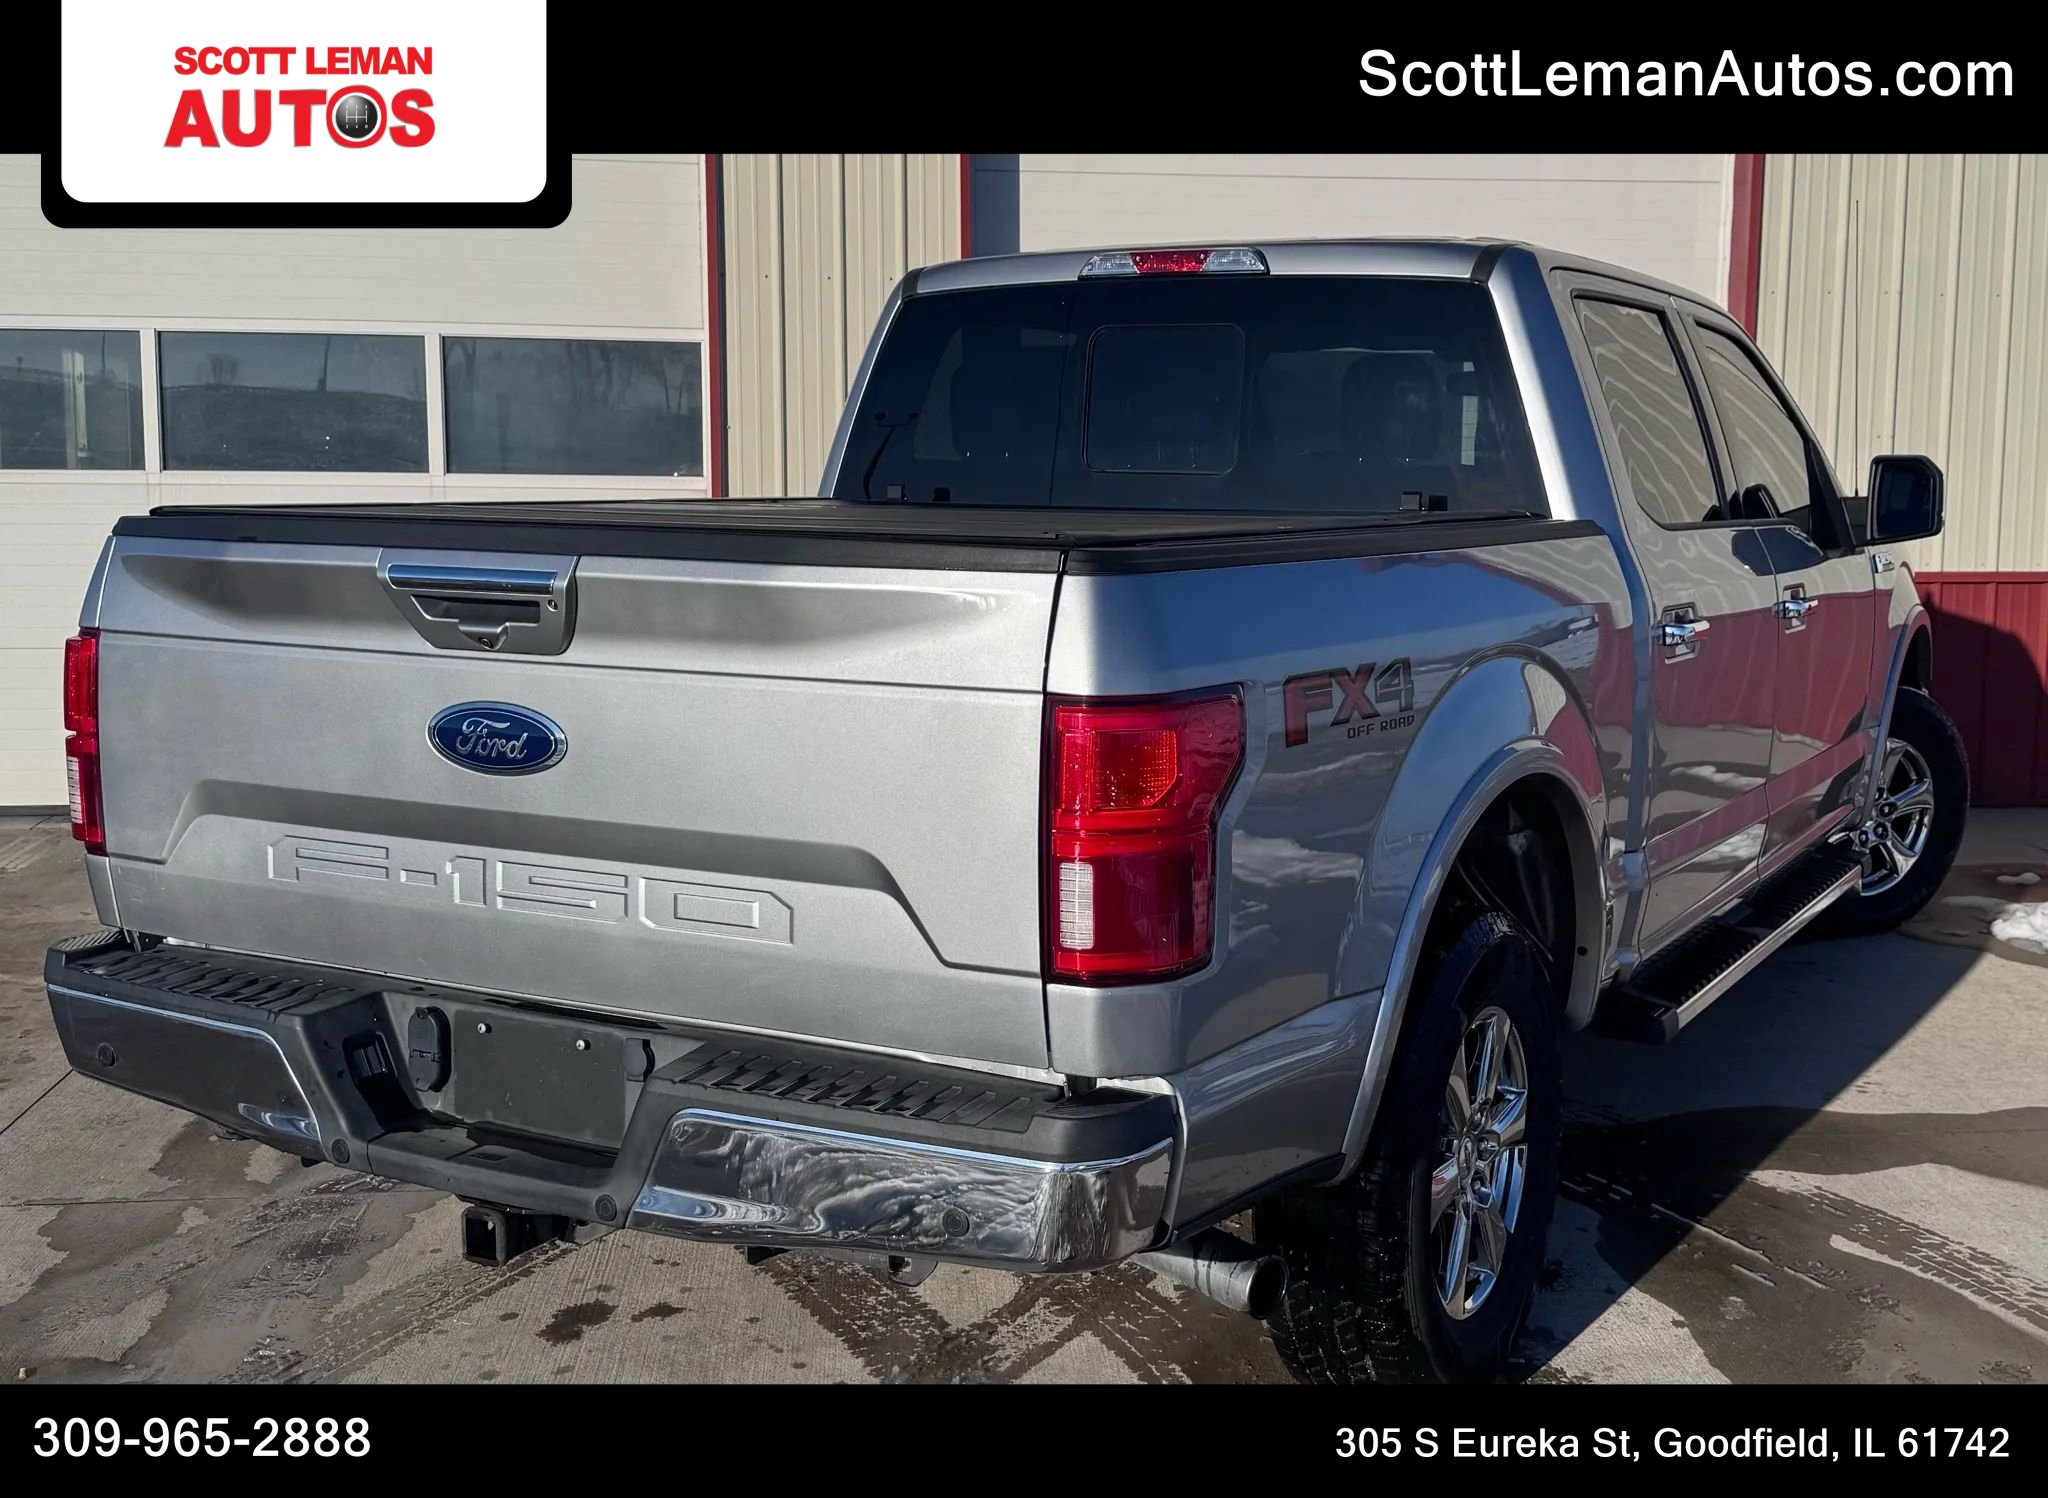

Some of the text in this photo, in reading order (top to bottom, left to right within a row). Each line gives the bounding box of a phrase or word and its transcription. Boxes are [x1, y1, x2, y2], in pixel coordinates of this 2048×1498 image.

[1283, 656, 1415, 748] FX4
[1347, 714, 1415, 740] OFF ROAD
[456, 717, 528, 760] Ford
[266, 834, 794, 945] F-150
